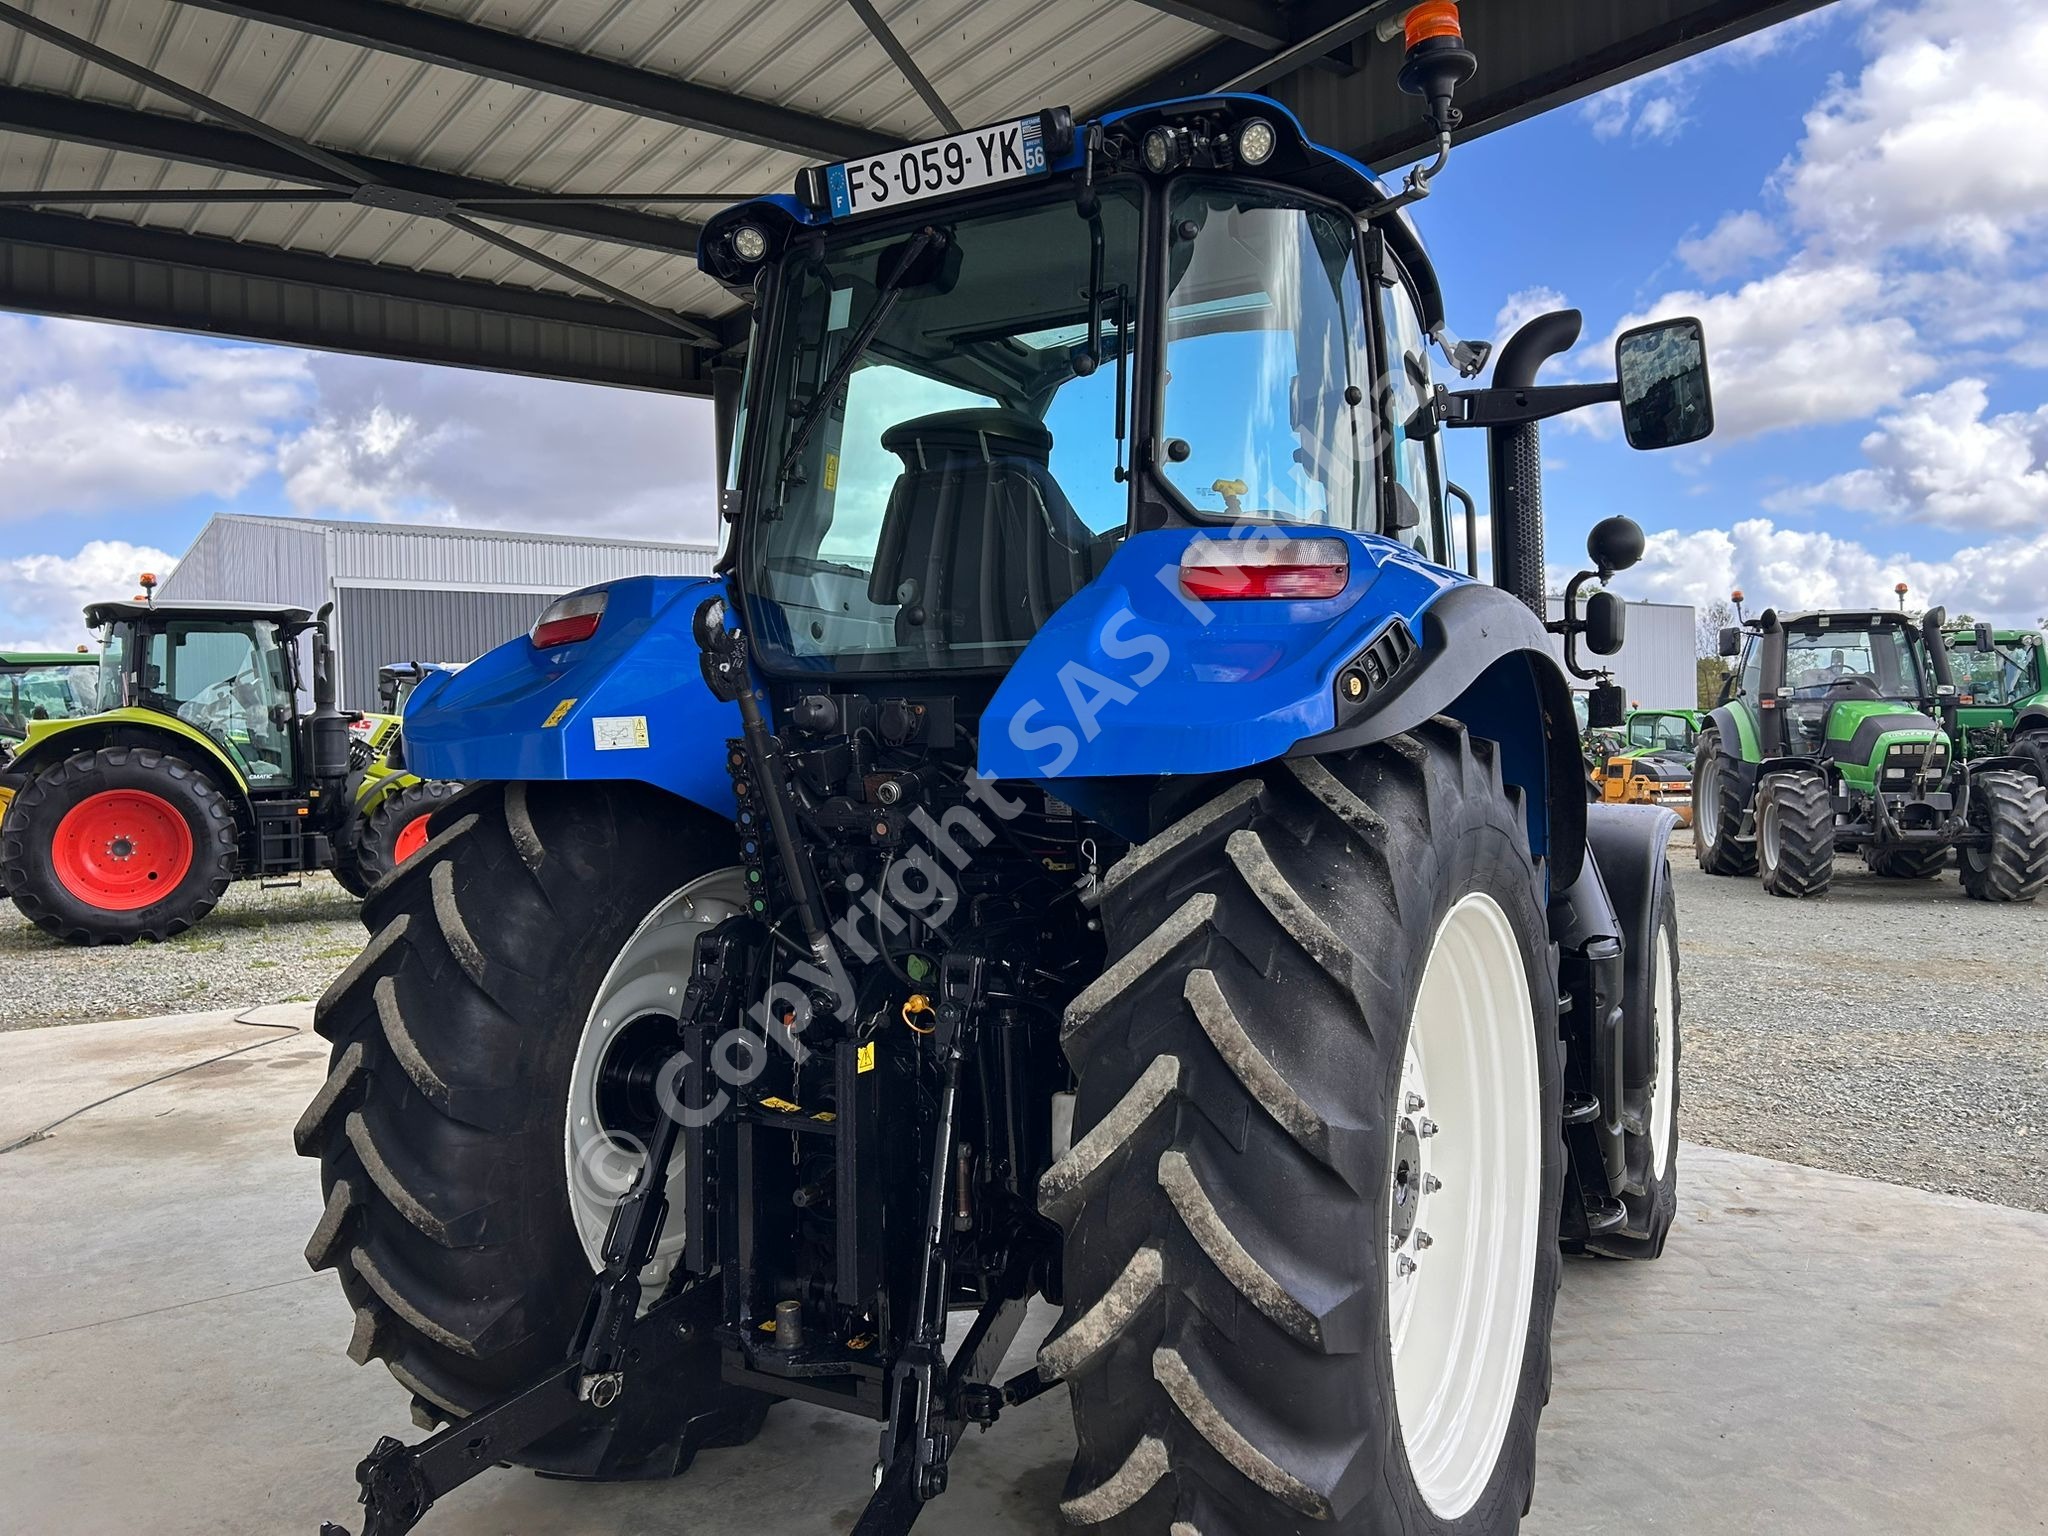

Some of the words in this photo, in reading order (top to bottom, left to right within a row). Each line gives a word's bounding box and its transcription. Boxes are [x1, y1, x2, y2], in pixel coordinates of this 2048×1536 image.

[847, 127, 1023, 207] FS-059-YK
[1025, 146, 1045, 169] 56
[836, 196, 843, 208] F
